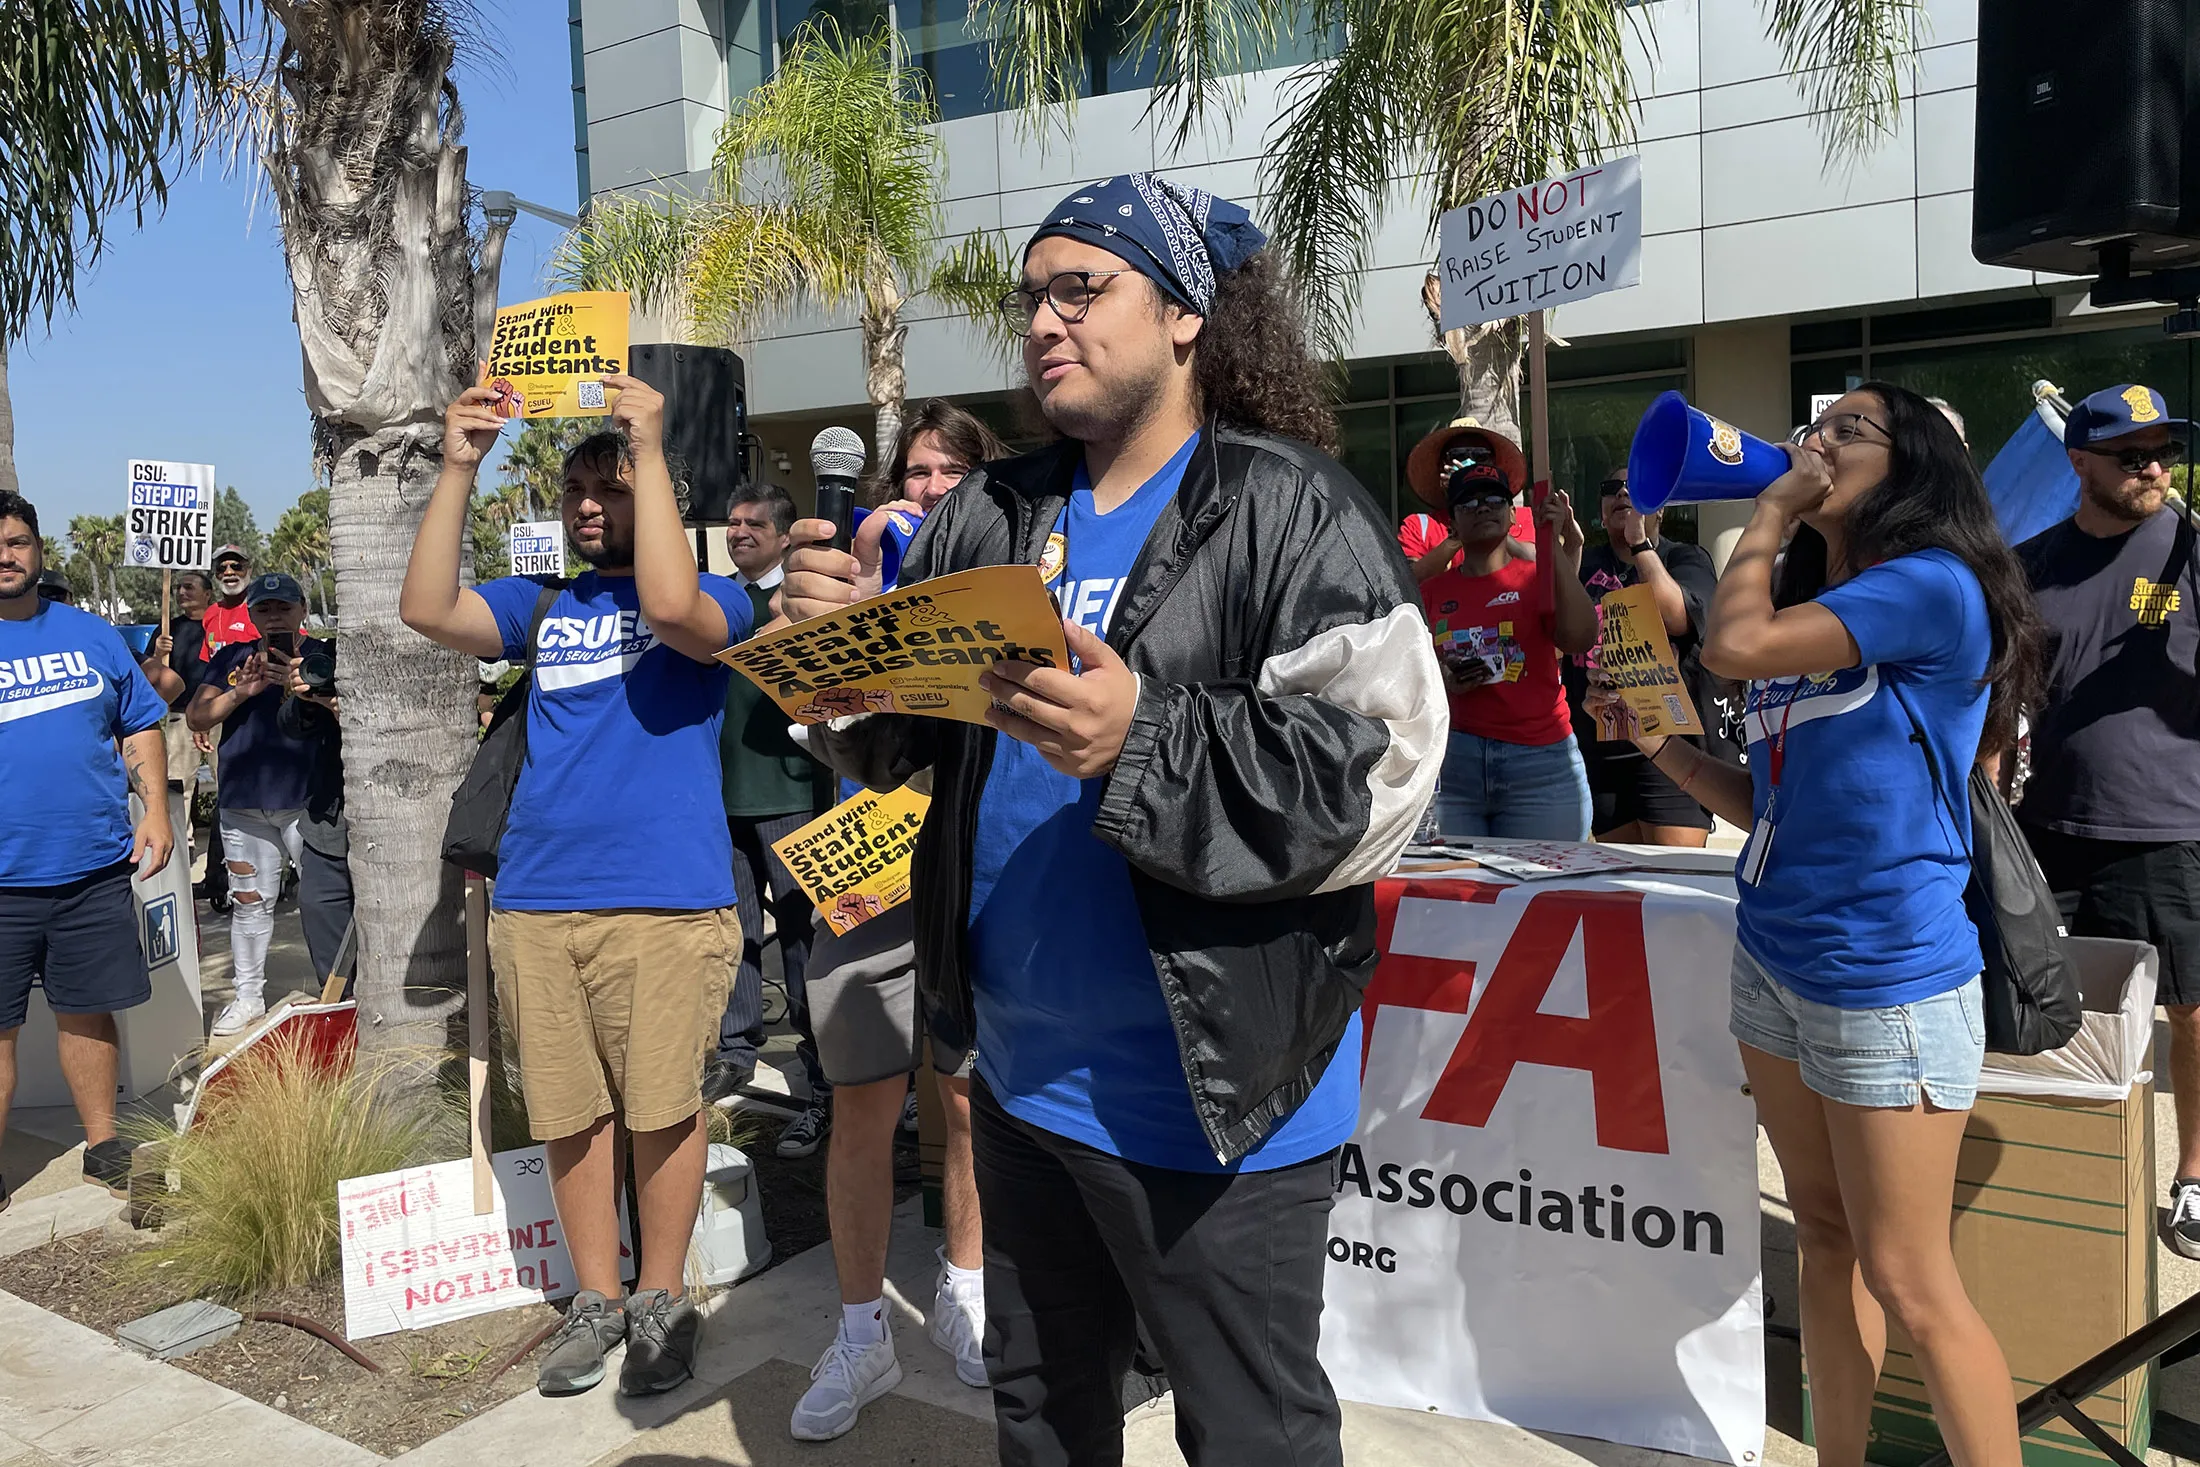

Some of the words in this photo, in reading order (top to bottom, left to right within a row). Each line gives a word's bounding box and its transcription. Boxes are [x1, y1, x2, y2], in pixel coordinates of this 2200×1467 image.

[1468, 199, 1507, 242] DO
[1516, 170, 1603, 229] NOT
[1446, 242, 1510, 283] RAISE
[1526, 211, 1622, 253] STUDENT
[1465, 255, 1606, 311] TUITION
[494, 317, 555, 345] Staff
[557, 314, 577, 336] &
[497, 308, 536, 328] Stand
[540, 303, 574, 321] With
[490, 335, 597, 361] Student
[487, 354, 620, 379] Assistants
[134, 463, 167, 482] CSU:
[134, 484, 172, 506] STEP
[173, 487, 196, 507] UP
[198, 501, 209, 510] OR
[131, 508, 207, 537] STRIKE
[514, 526, 534, 538] CSU:
[159, 537, 207, 566] OUT
[514, 539, 538, 553] STEP
[539, 538, 551, 552] UP
[515, 554, 560, 573] STRIKE
[1498, 591, 1521, 601] CFA
[2130, 595, 2181, 611] STRIKE
[1609, 603, 1628, 619] With
[731, 621, 841, 661] Stand
[847, 595, 933, 624] With
[744, 614, 900, 672] Staff
[910, 604, 955, 627] &
[565, 650, 594, 662] SEIU
[594, 644, 621, 661] Local
[759, 621, 1006, 685] Student
[778, 643, 1057, 699] Assistants
[7, 688, 32, 700] SEIU
[34, 682, 60, 695] Local
[62, 678, 88, 690] 2579
[900, 692, 943, 702] CSUEU
[783, 823, 836, 859] Stand
[836, 799, 878, 828] With
[791, 820, 868, 873] Staff
[868, 808, 894, 831] &
[801, 812, 922, 889] Student
[1338, 1143, 1725, 1256] Association
[404, 1259, 560, 1311] TUITION
